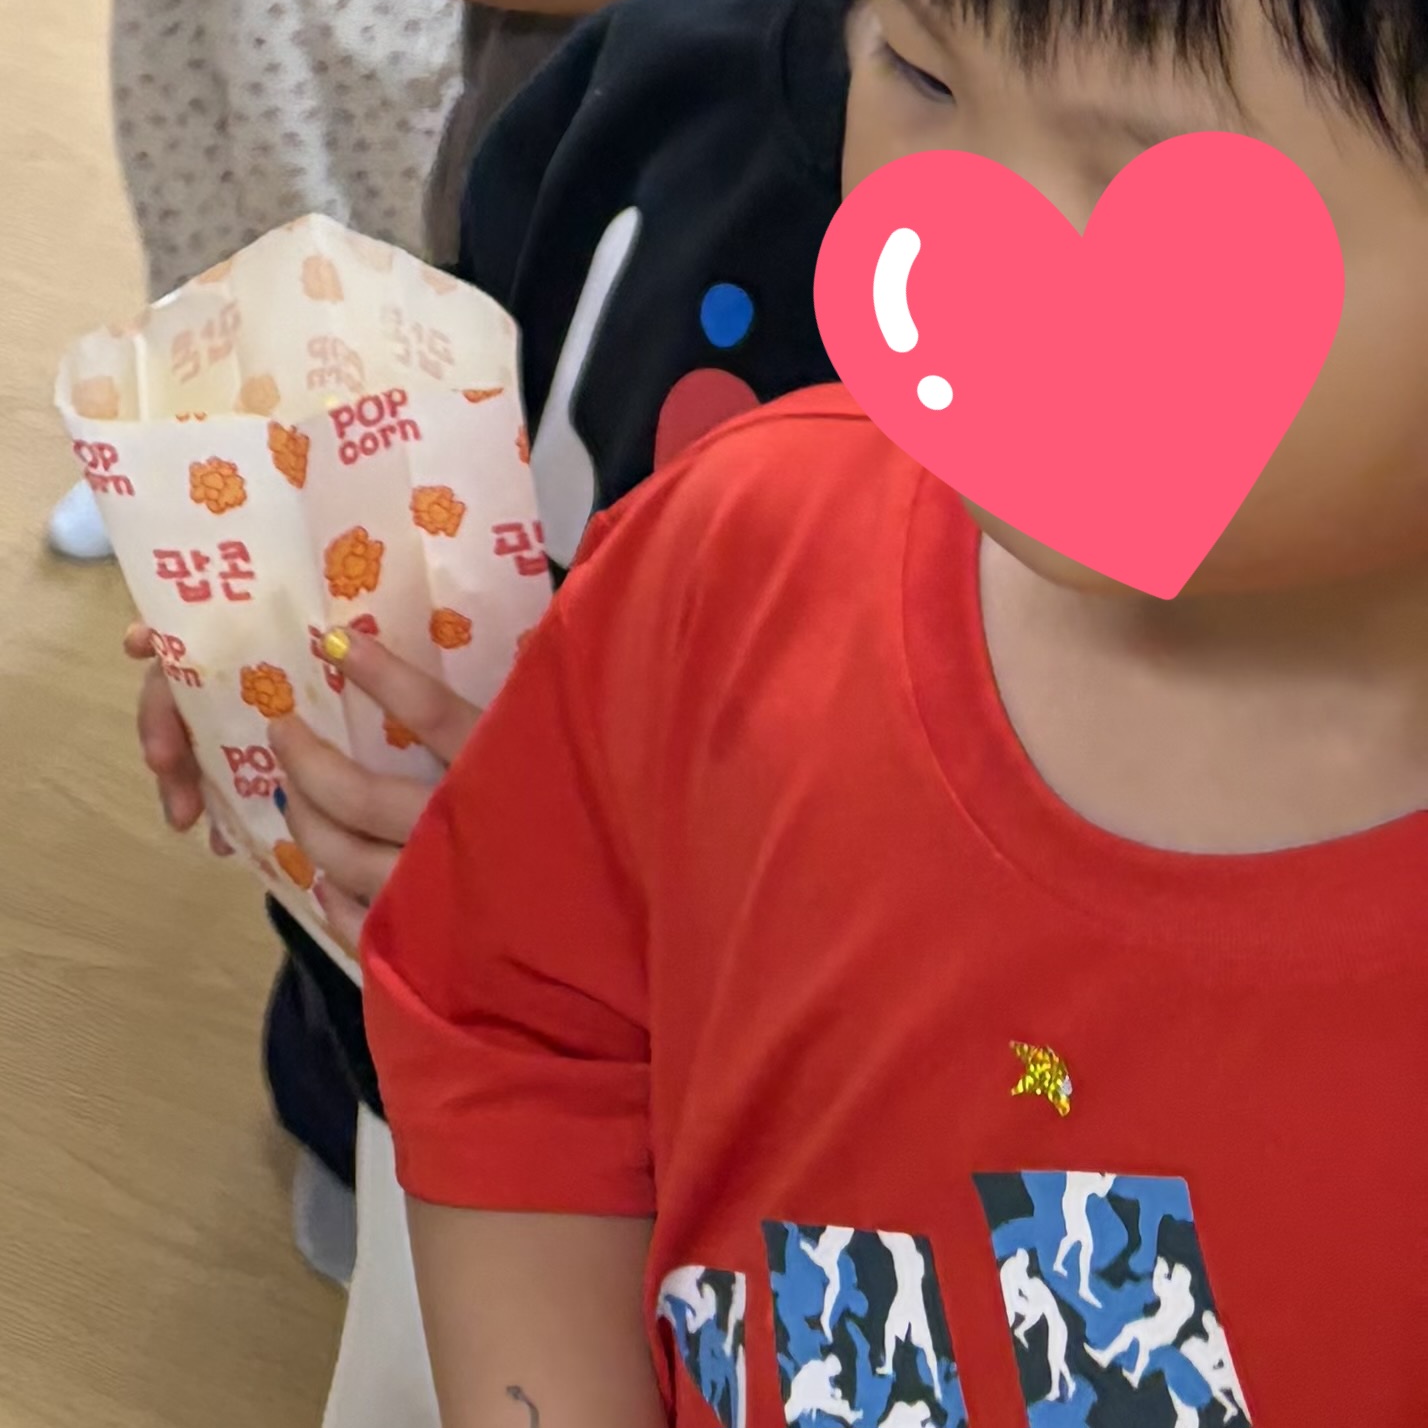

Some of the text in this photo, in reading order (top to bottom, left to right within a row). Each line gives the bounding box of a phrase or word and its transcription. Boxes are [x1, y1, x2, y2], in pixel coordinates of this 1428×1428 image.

[327, 387, 408, 439] POP
[73, 439, 119, 471] OP
[153, 539, 256, 604] 팝콘
[491, 518, 548, 578] 팝
[220, 745, 275, 773] PO
